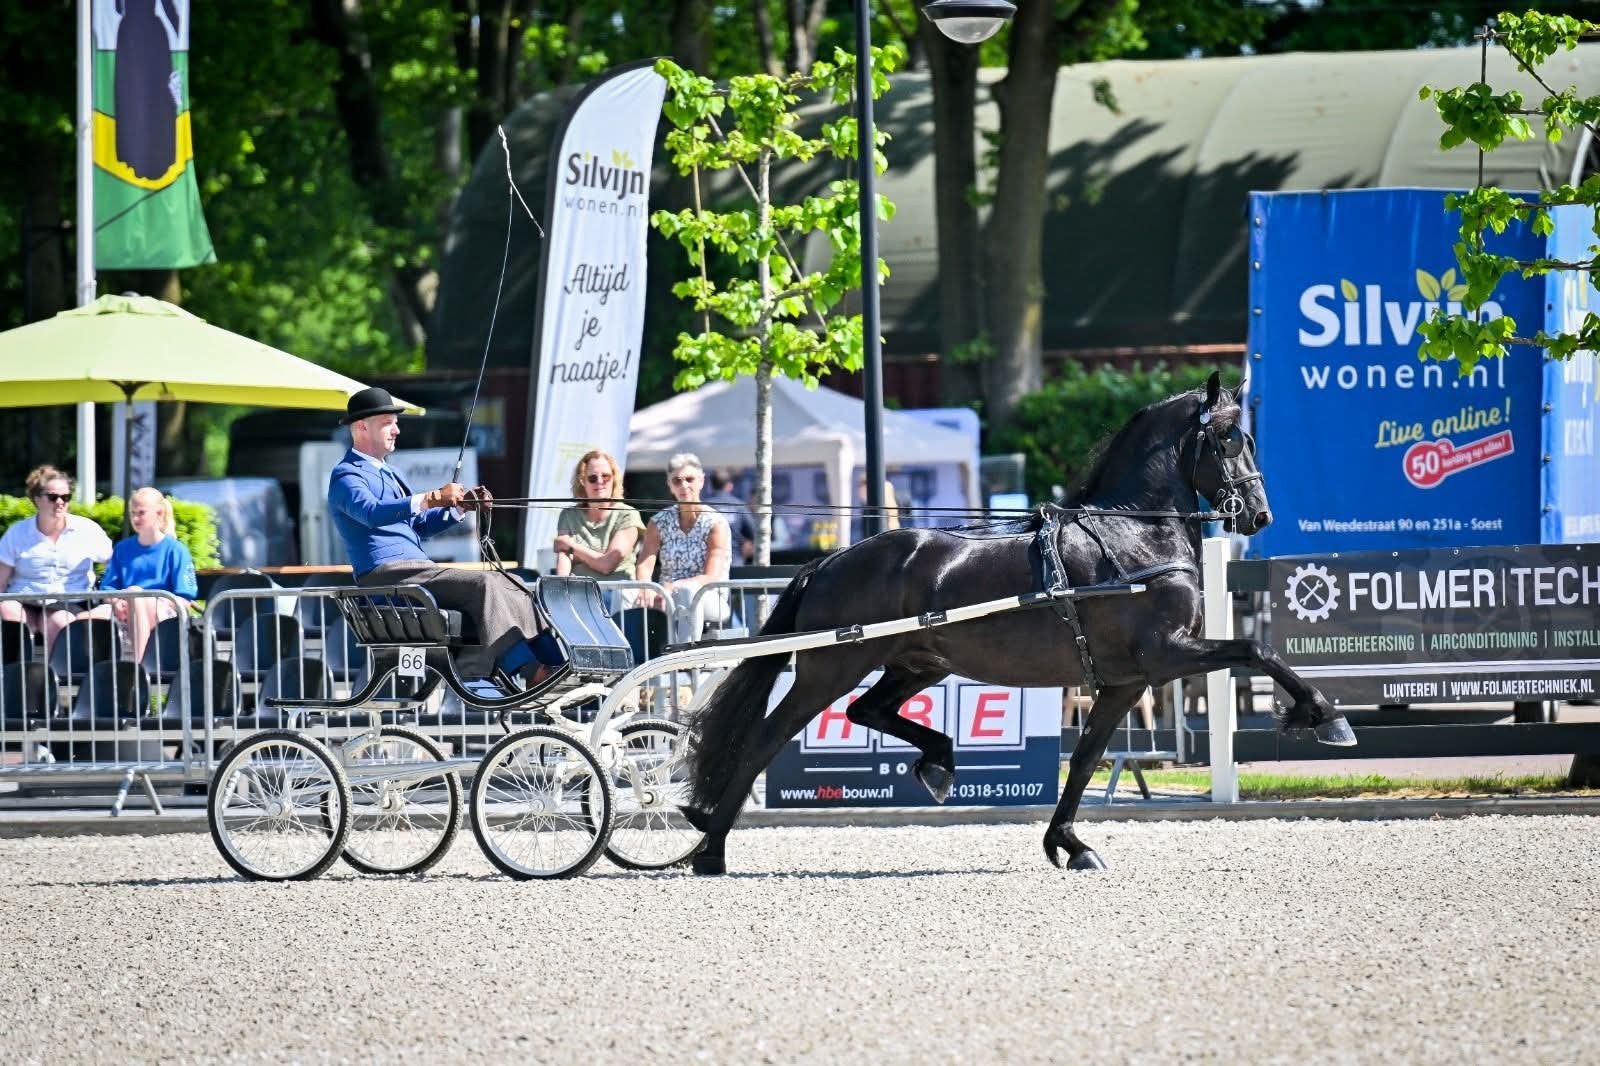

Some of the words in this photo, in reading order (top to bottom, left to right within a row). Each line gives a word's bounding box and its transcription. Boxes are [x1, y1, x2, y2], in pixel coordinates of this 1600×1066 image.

[566, 151, 645, 200] Silvijn
[564, 197, 644, 218] wonen.nl
[564, 263, 630, 306] Altijd
[575, 310, 601, 351] je
[1301, 357, 1505, 389] wonen.nl
[1375, 420, 1425, 449] Live
[1431, 396, 1512, 438] online!
[1298, 519, 1321, 532] Van
[1323, 518, 1396, 532] Weedestraat
[1397, 518, 1413, 531] 90
[1414, 520, 1431, 531] en
[1433, 518, 1461, 531] 251a
[1471, 518, 1503, 531] Soest
[1349, 568, 1495, 611] FOLMER
[1510, 565, 1600, 606] TECH
[1286, 634, 1415, 654] KLIMAATBEHEERSING
[1431, 631, 1538, 650] AIRCONDITIONING
[401, 653, 423, 670] 66
[1383, 682, 1438, 698] LUNTEREN
[1451, 678, 1595, 697] WWW.FOLMERTECHNIEK.NL
[780, 784, 894, 800] www.hbebouw.nl
[959, 783, 1044, 798] 0318-510107
